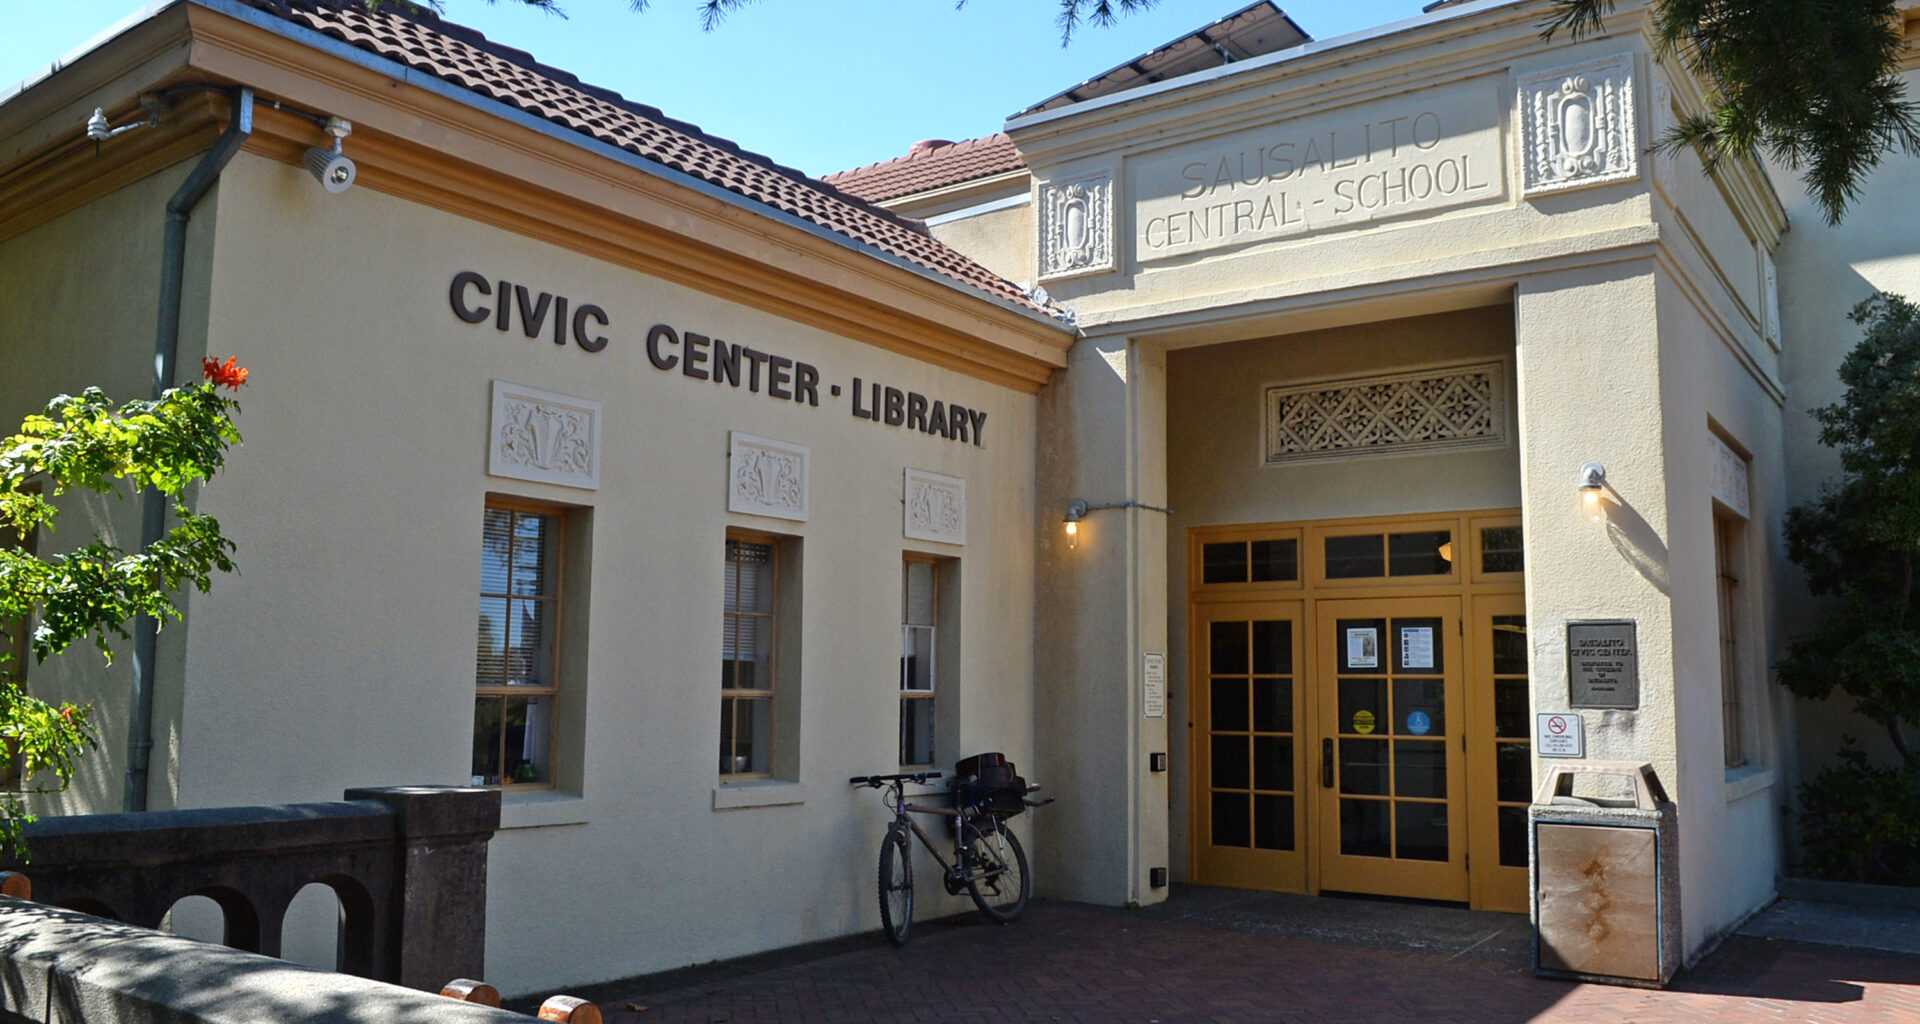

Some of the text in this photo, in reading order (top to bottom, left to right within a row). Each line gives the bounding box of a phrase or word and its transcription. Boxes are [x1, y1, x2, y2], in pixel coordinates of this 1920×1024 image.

[1145, 192, 1302, 249] CENTRAL
[1334, 155, 1488, 216] SCHOOL
[1181, 112, 1441, 201] SAUSALITO
[450, 271, 609, 353] CIVIC
[646, 325, 819, 406] CENTER
[852, 378, 987, 447] LIBRARY
[1570, 649, 1595, 657] CIVIC
